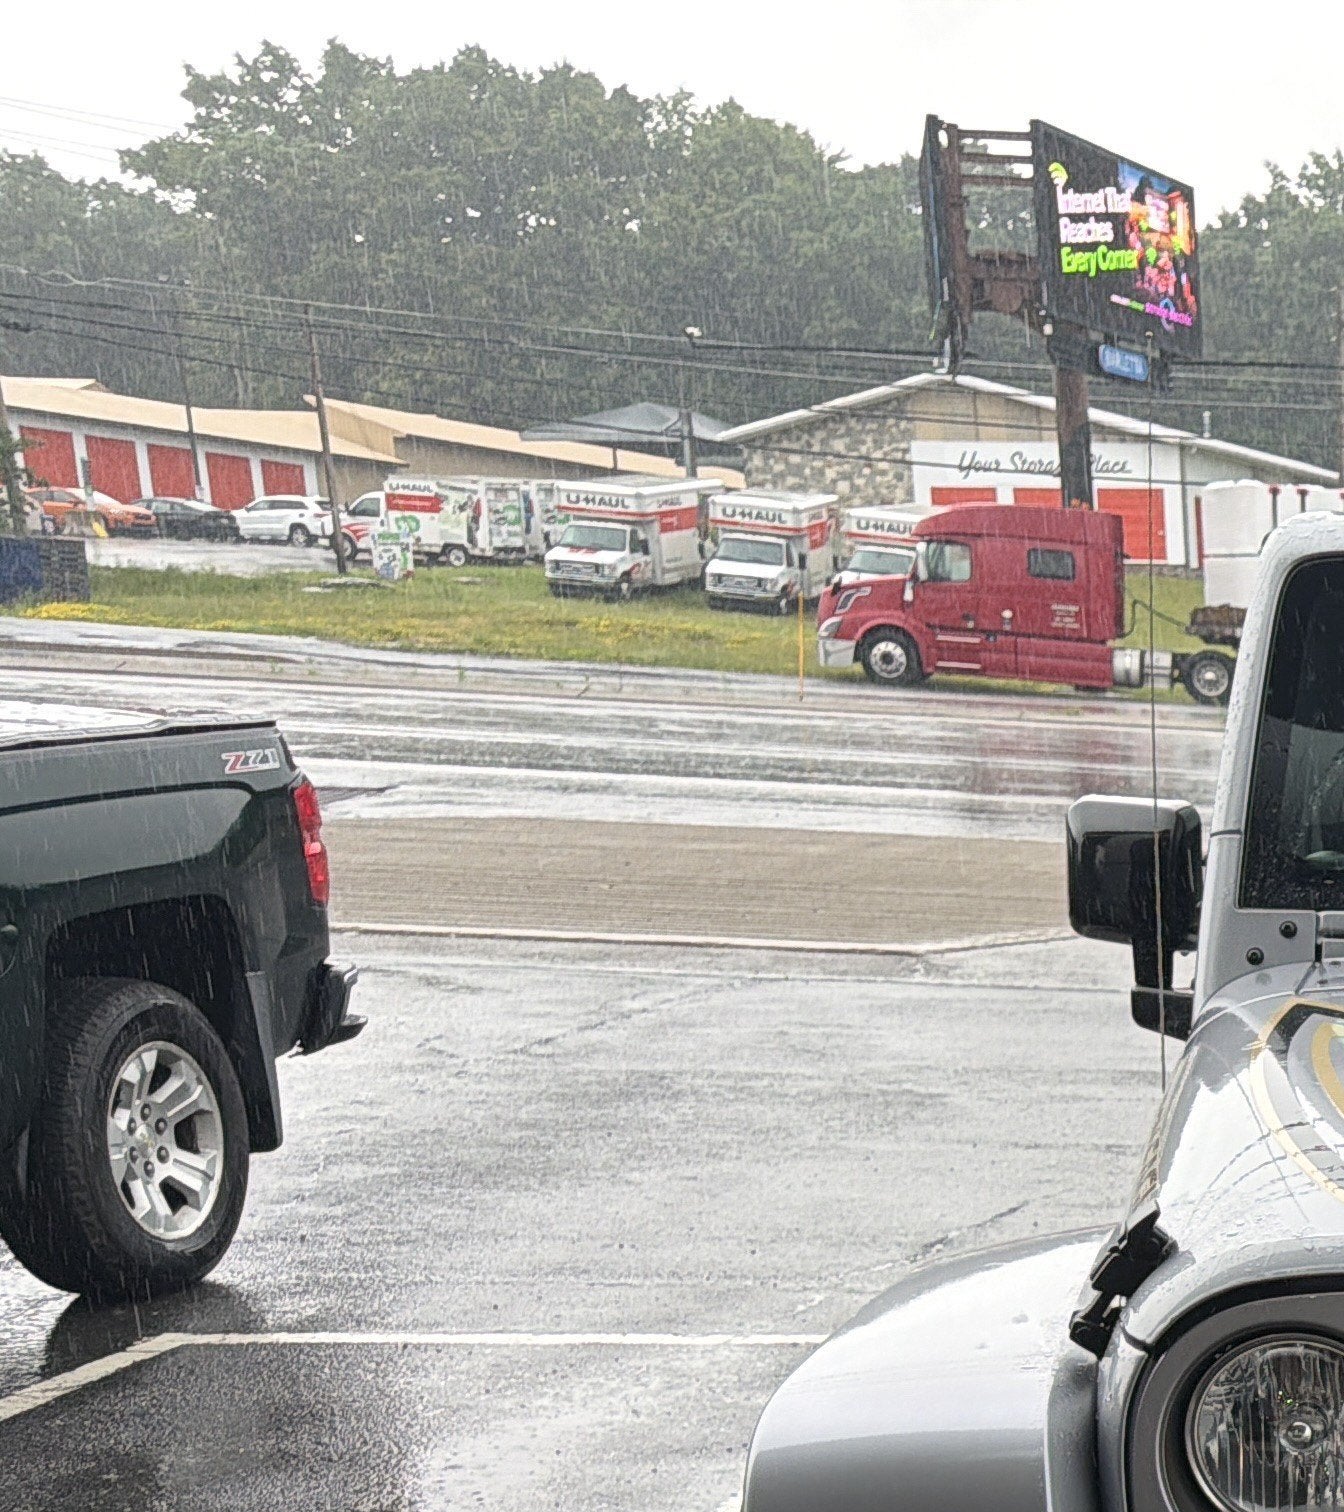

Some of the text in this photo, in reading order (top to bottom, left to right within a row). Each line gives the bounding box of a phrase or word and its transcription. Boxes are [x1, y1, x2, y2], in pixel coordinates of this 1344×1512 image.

[1057, 187, 1105, 214] Internet
[1059, 216, 1114, 243] Reaches
[1060, 245, 1139, 277] Every Corner
[958, 450, 1001, 479] Your
[1009, 451, 1061, 476] Stora
[221, 748, 280, 775] Z71
